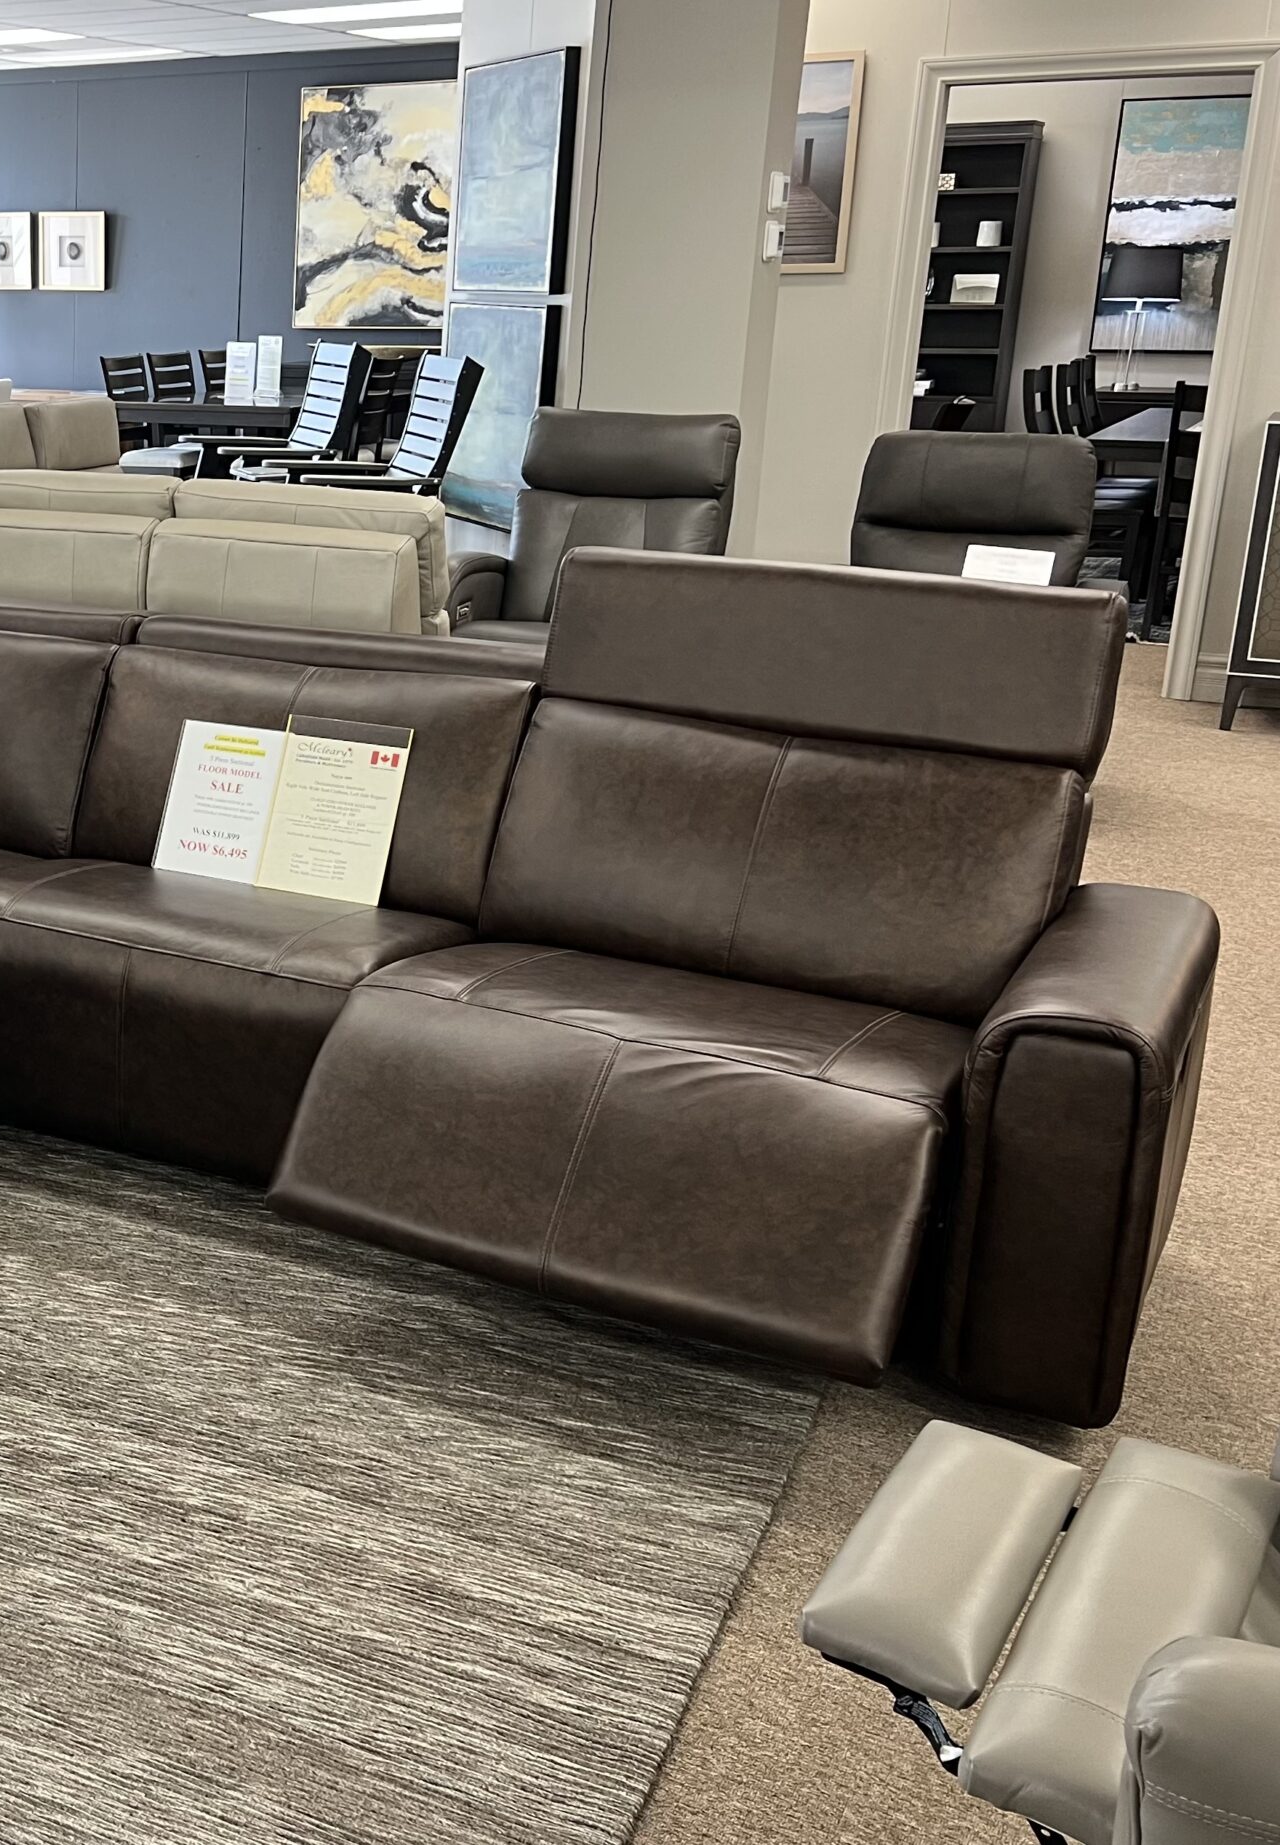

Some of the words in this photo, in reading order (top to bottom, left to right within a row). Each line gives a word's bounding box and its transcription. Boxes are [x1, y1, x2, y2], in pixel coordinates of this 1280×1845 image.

[198, 763, 228, 775] FLOOR
[229, 768, 263, 780] MODEL
[210, 780, 244, 795] SALE
[193, 827, 211, 836] WAS
[179, 839, 210, 853] NOW
[212, 844, 248, 859] $6,495
